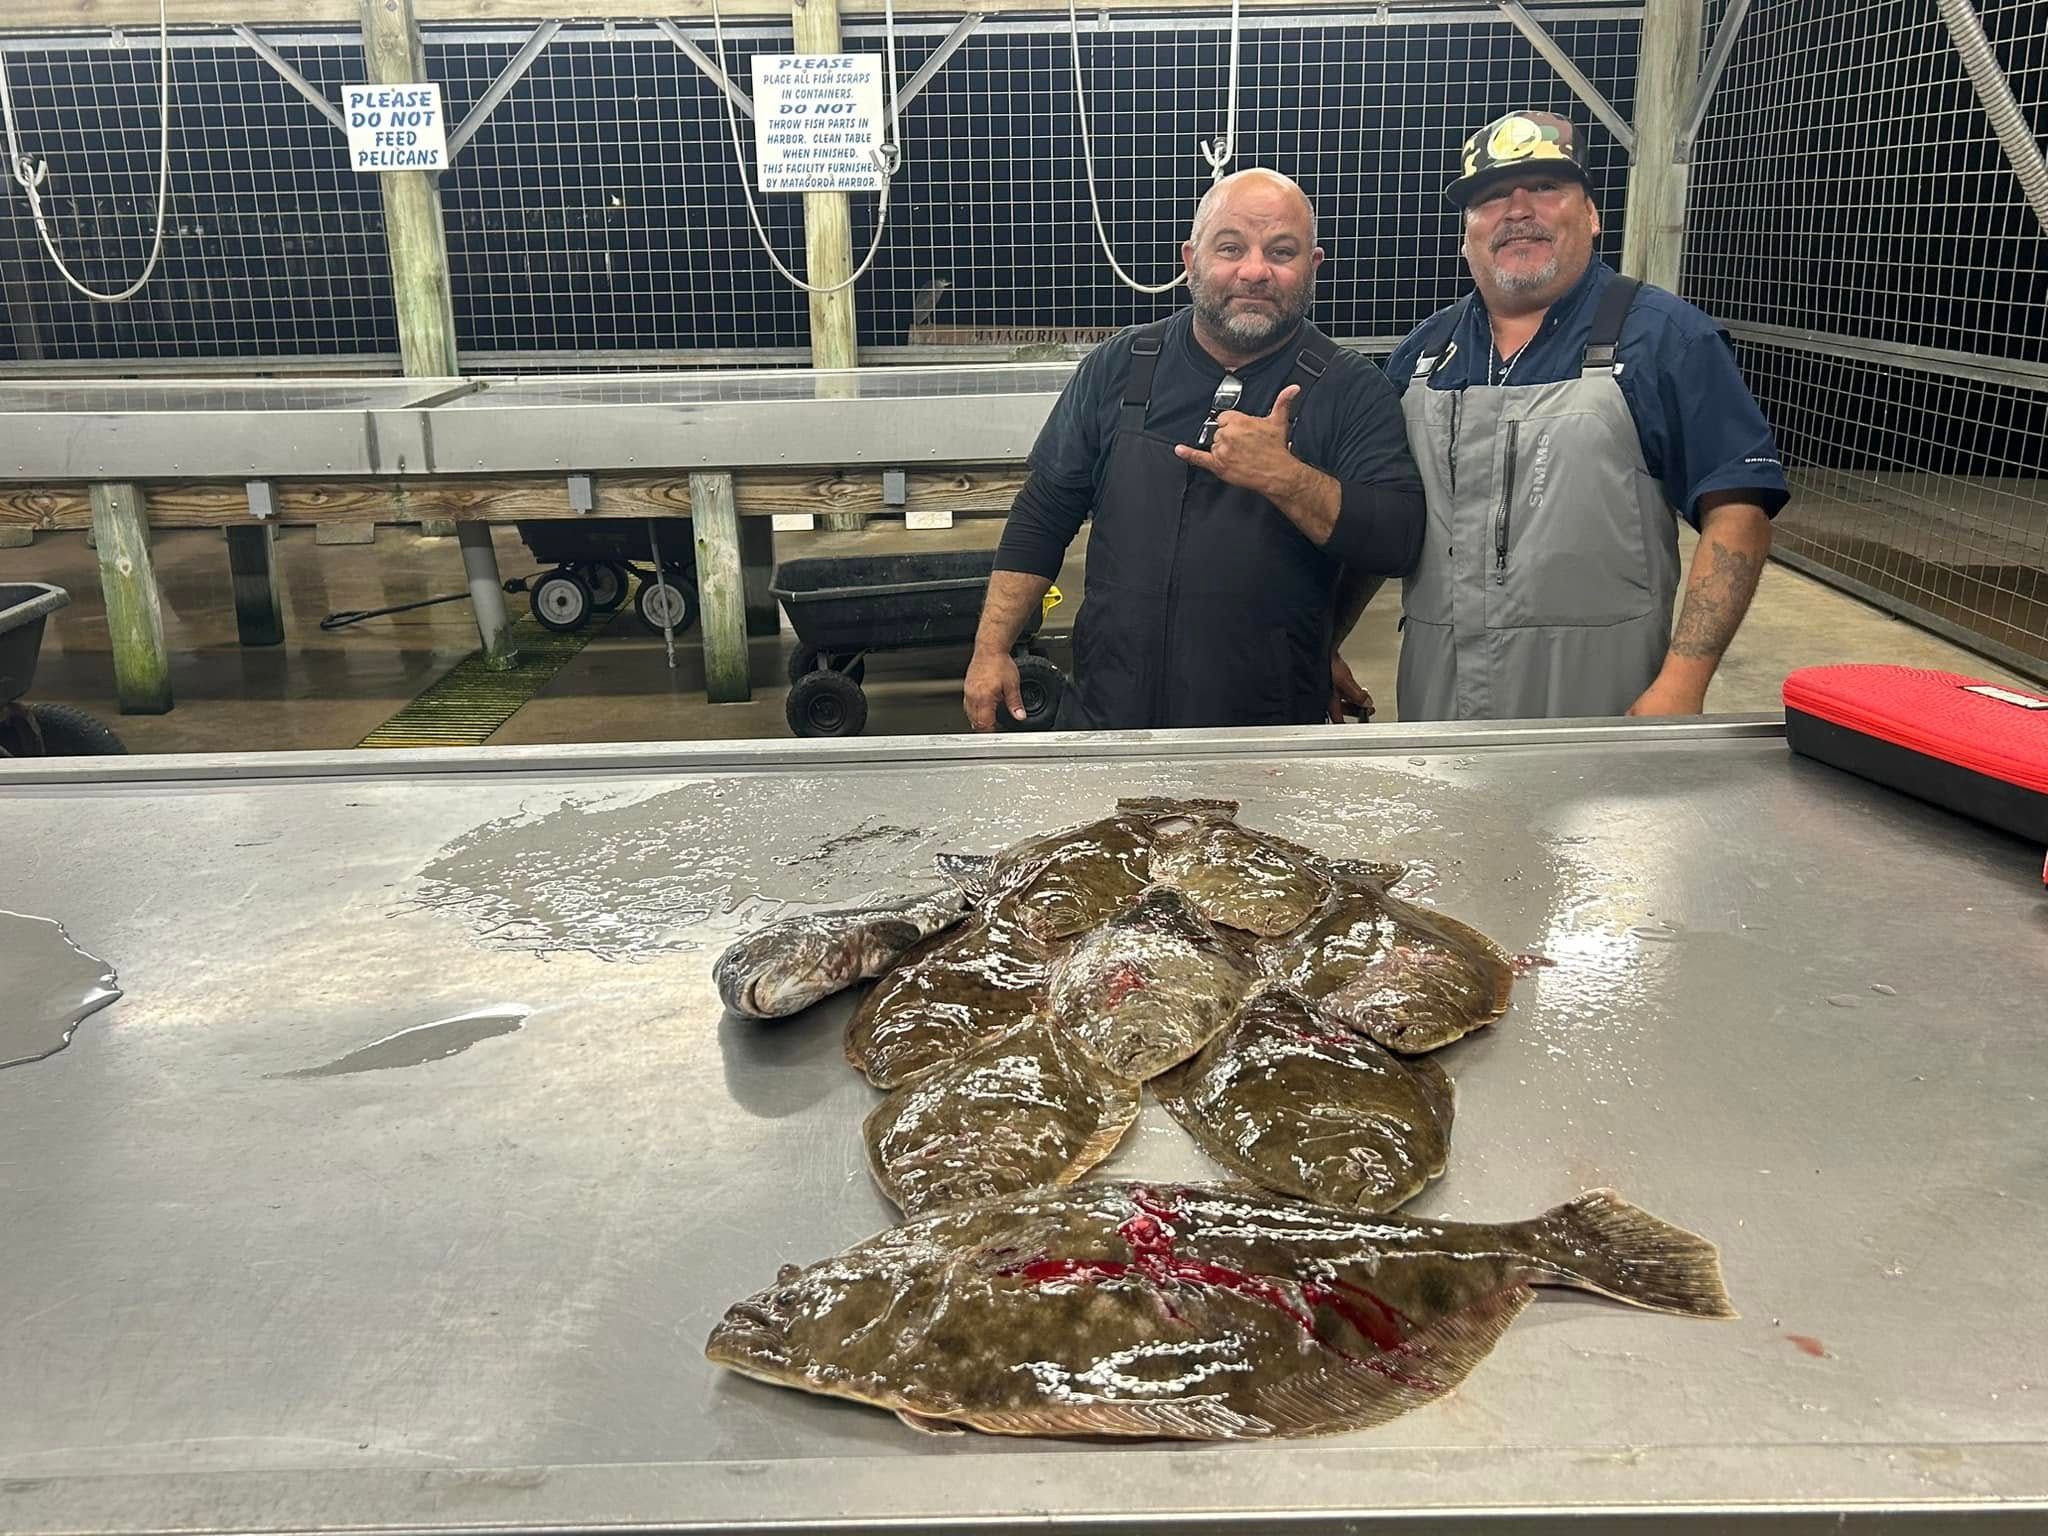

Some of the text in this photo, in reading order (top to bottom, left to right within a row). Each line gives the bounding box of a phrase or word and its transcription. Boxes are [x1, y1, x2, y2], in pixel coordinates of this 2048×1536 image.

[779, 58, 854, 69] PLEASE
[763, 72, 871, 85] PLACE ALL FISH SCRAPS
[781, 88, 854, 100] IN CONTAINERS.
[350, 92, 432, 108] PLEASE
[779, 103, 857, 114] DO NOT
[351, 111, 436, 128] DO NOT
[768, 118, 869, 129] THROW FISH PARTS IN
[375, 131, 417, 147] FEED
[767, 133, 872, 144] HARBOR. CLEAN TABLE
[358, 150, 439, 166] PELICANS
[782, 148, 858, 159] WHEN FINISHED.
[763, 164, 783, 174] THIS
[786, 163, 825, 174] FACILITY
[766, 177, 878, 188] BY MATAGORDA HARBOR.
[1529, 433, 1550, 508] SIMMS
